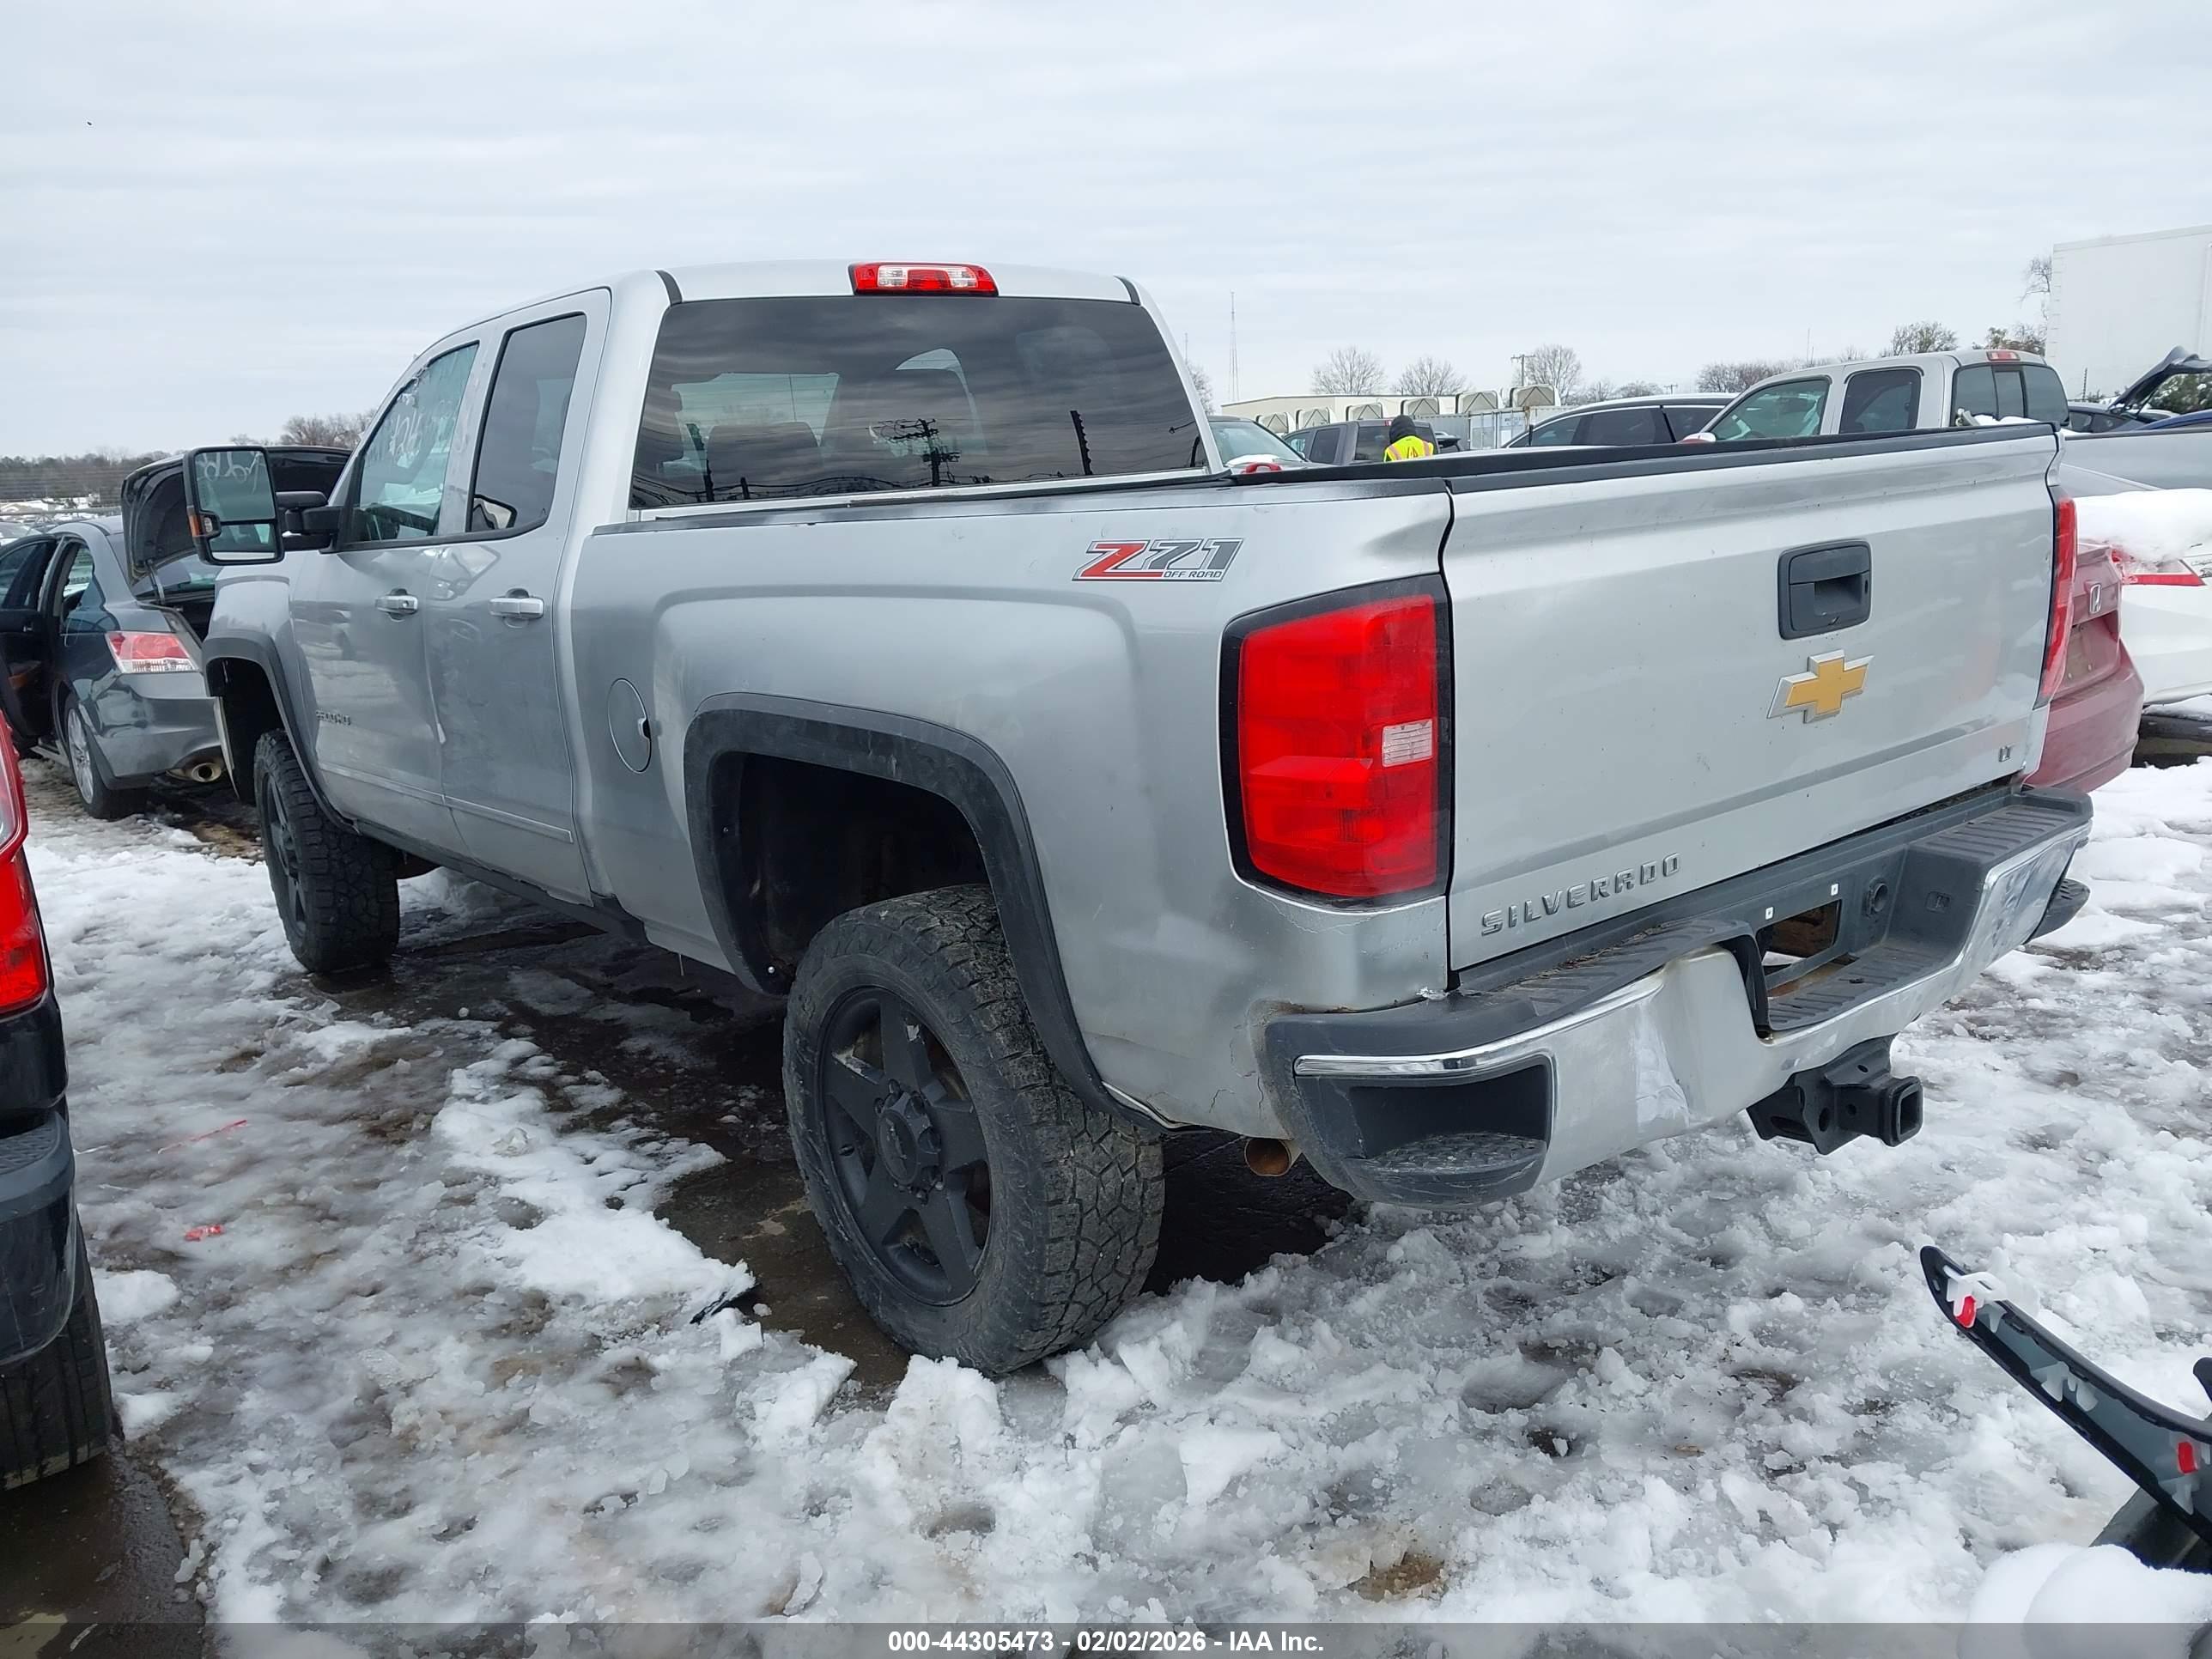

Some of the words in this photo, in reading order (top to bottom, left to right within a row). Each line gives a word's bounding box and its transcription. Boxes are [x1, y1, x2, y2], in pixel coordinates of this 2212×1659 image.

[1073, 538, 1243, 580] Z71
[1163, 570, 1186, 579] OFF
[1188, 570, 1223, 579] ROAD
[1481, 852, 1680, 936] SILVERADO
